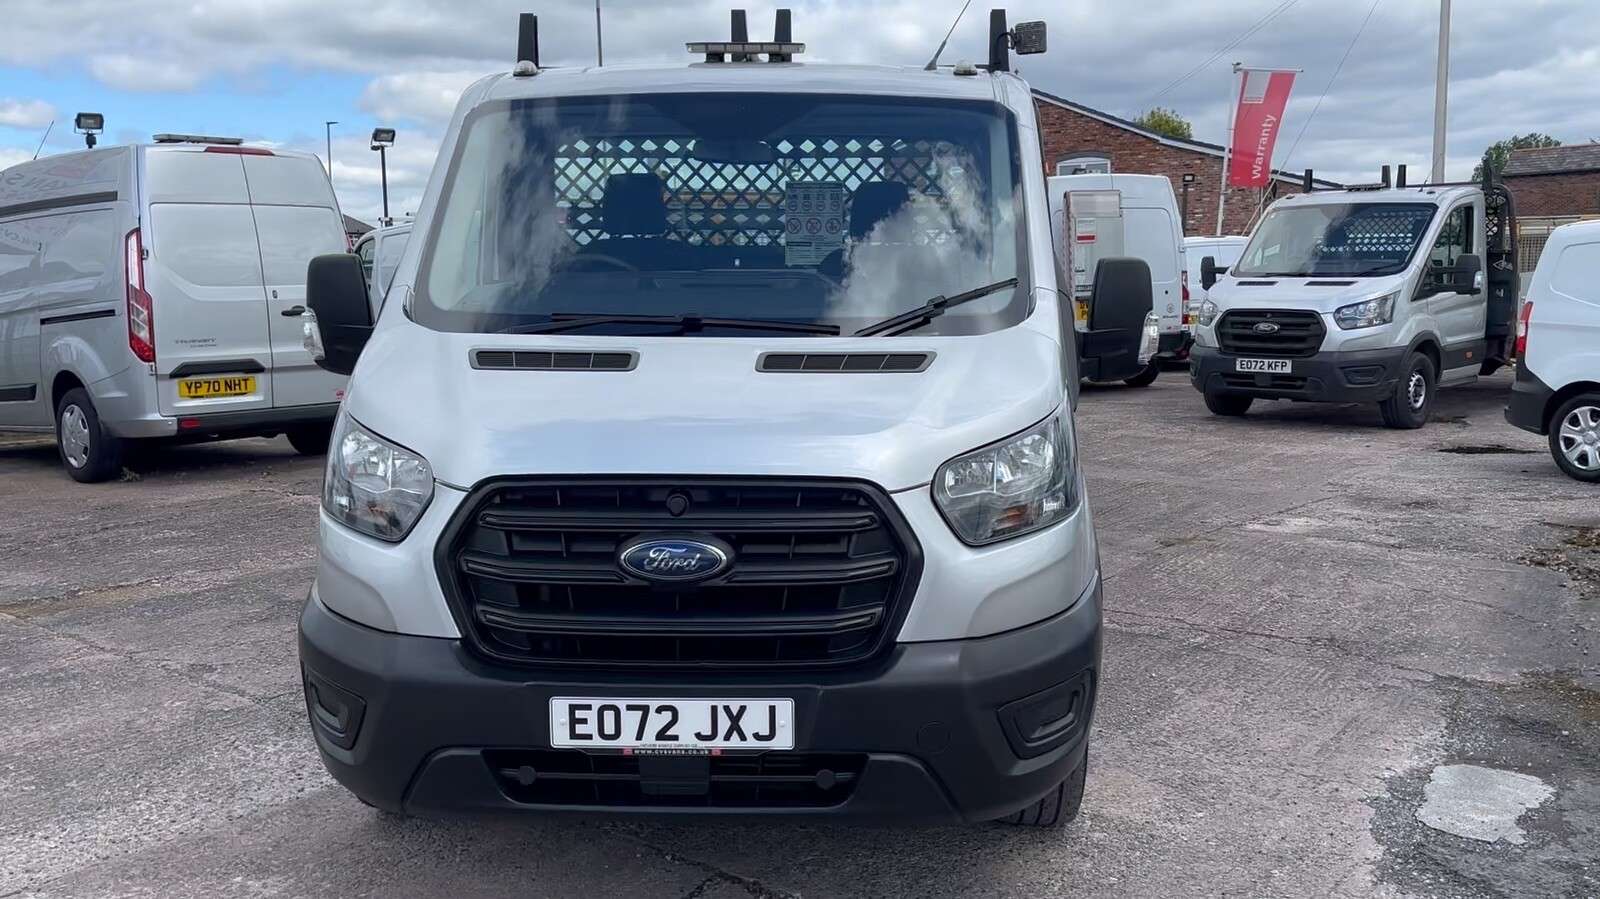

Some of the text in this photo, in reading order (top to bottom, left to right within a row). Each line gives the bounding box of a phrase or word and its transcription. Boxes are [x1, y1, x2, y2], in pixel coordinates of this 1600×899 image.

[1252, 114, 1277, 179] Warranty
[1267, 360, 1287, 371] KFP
[185, 379, 249, 394] YP70 NHT
[644, 546, 701, 570] Ford
[694, 705, 776, 742] JXJ
